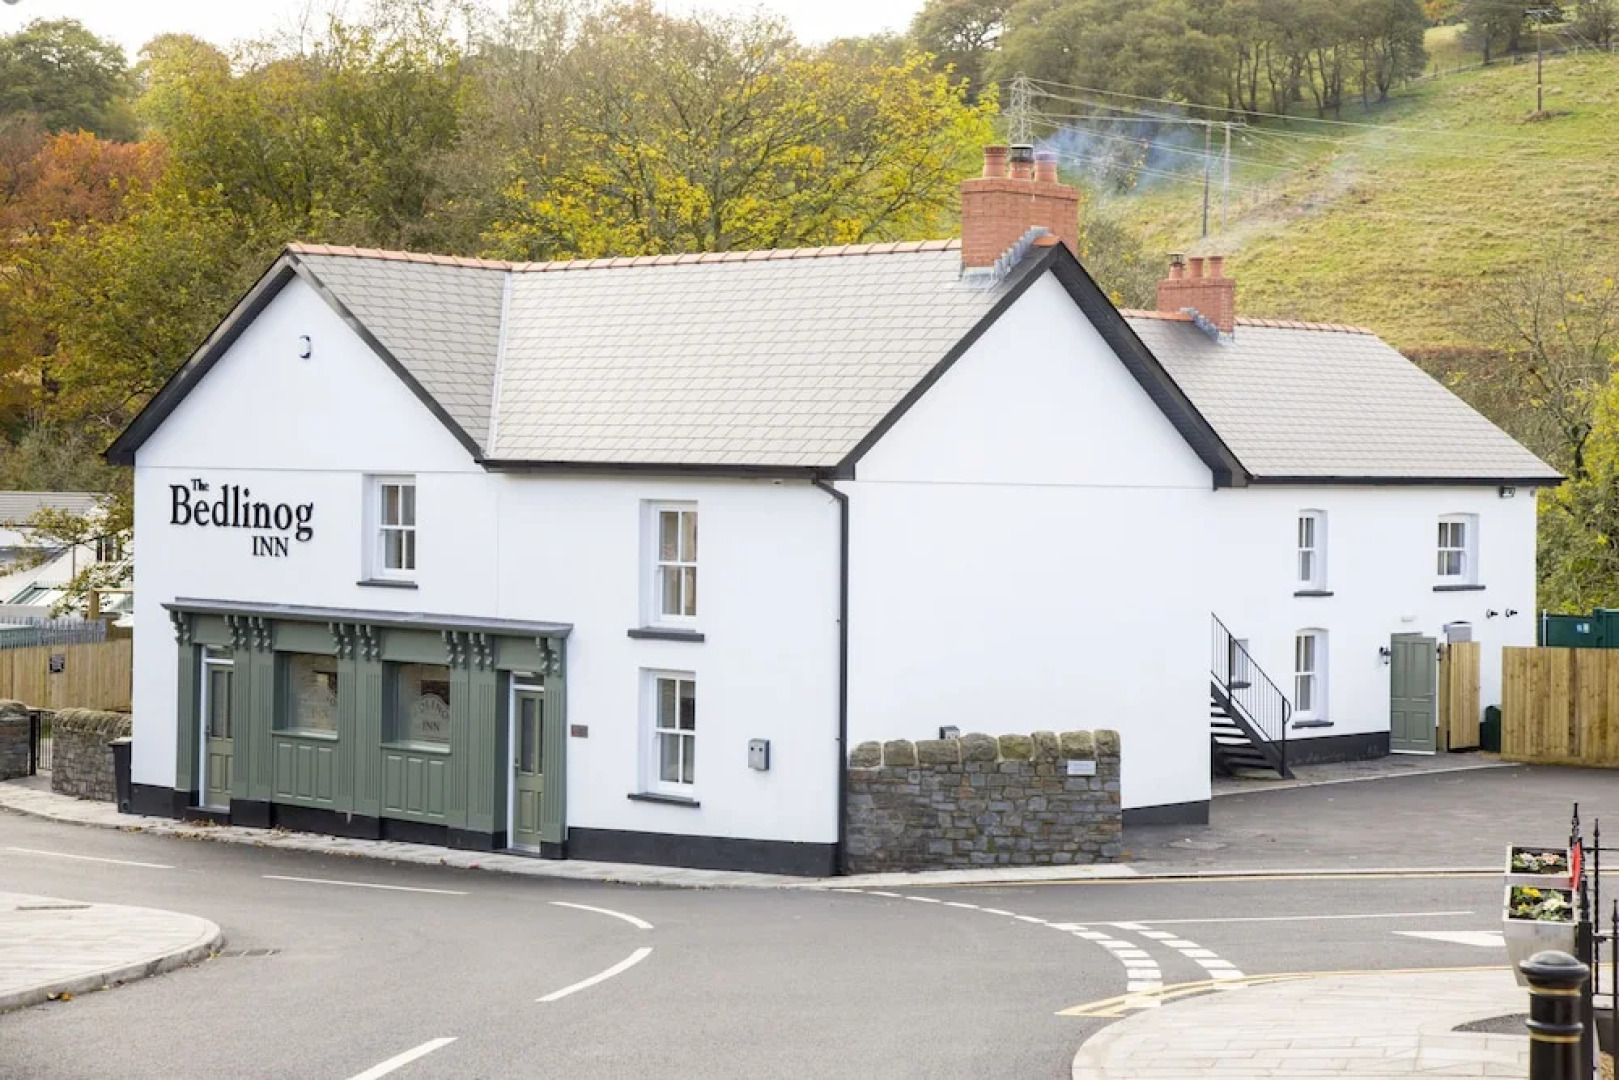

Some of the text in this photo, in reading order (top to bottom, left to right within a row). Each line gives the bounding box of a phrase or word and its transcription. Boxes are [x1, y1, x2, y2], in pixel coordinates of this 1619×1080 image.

[191, 479, 208, 492] The
[169, 484, 314, 542] Bedlinog
[252, 536, 288, 557] INN
